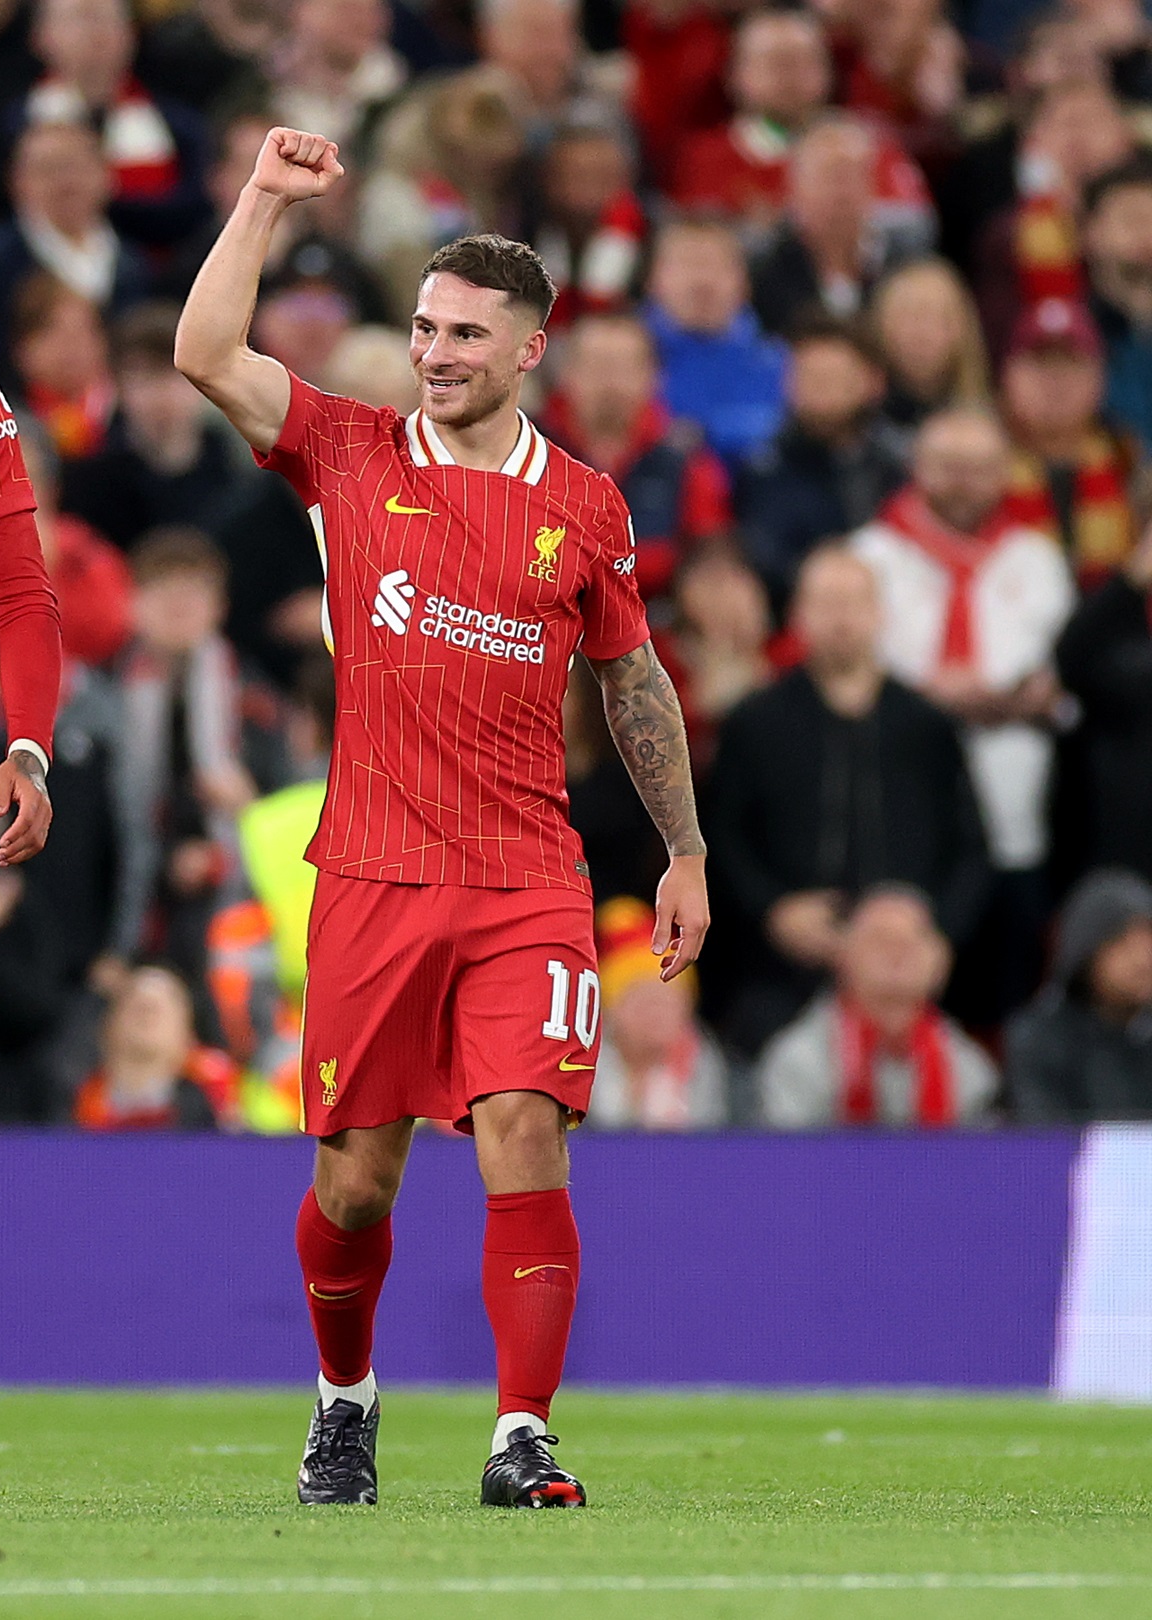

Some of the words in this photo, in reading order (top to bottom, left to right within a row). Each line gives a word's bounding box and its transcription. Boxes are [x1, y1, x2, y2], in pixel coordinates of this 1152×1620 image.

[419, 617, 545, 664] chartered
[423, 595, 543, 642] standard
[542, 959, 600, 1050] 10
